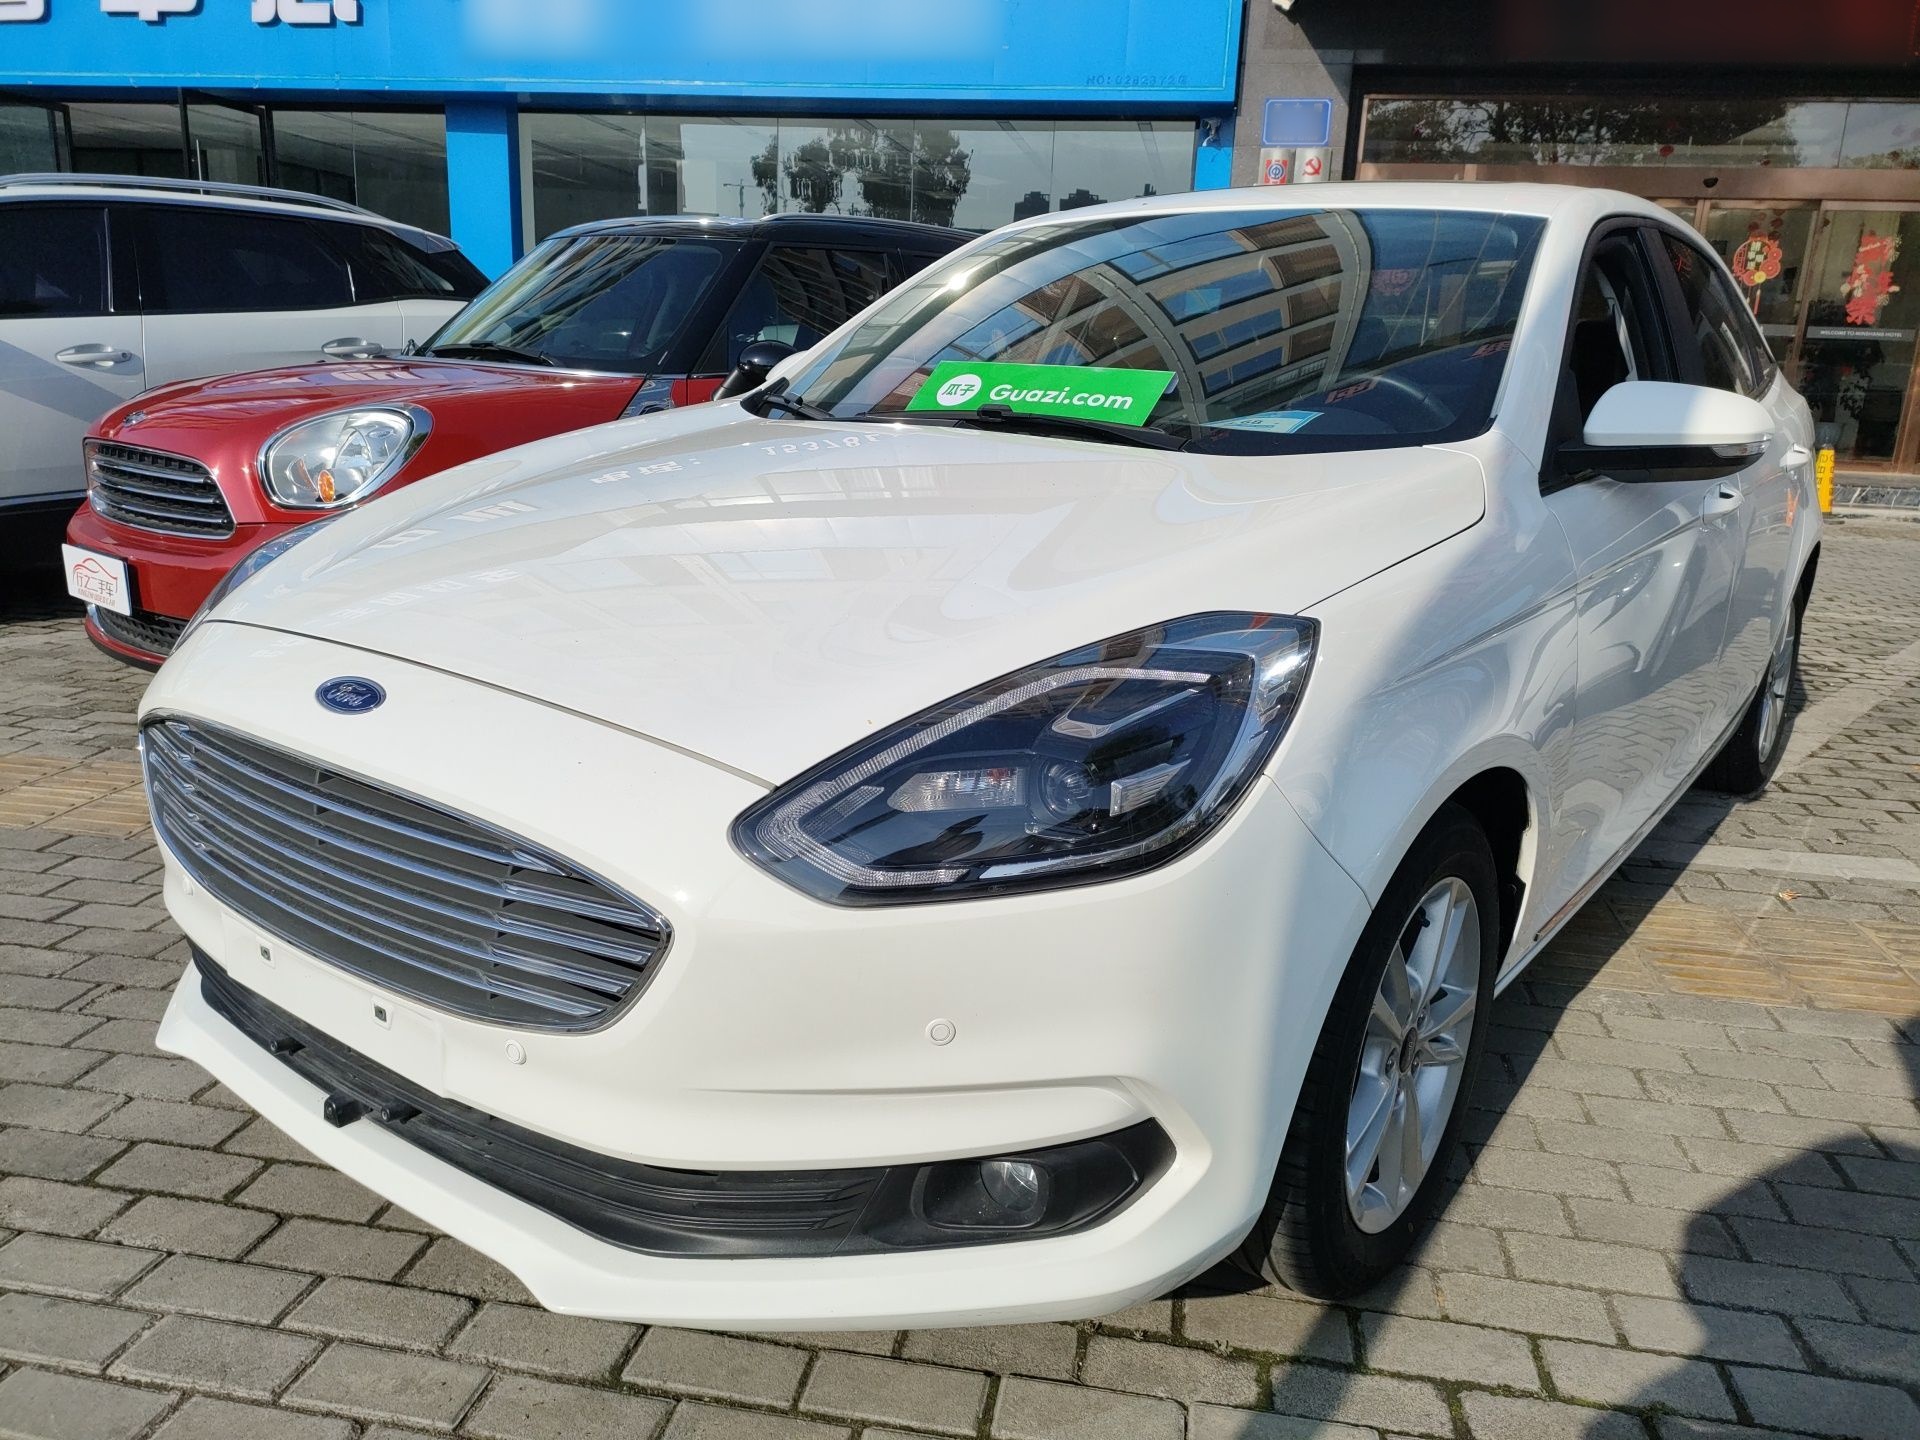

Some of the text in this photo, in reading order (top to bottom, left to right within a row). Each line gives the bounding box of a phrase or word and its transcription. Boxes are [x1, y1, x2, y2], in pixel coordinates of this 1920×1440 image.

[941, 383, 976, 396] 瓜子
[989, 384, 1134, 410] Guazi.com
[326, 682, 372, 707] Ford
